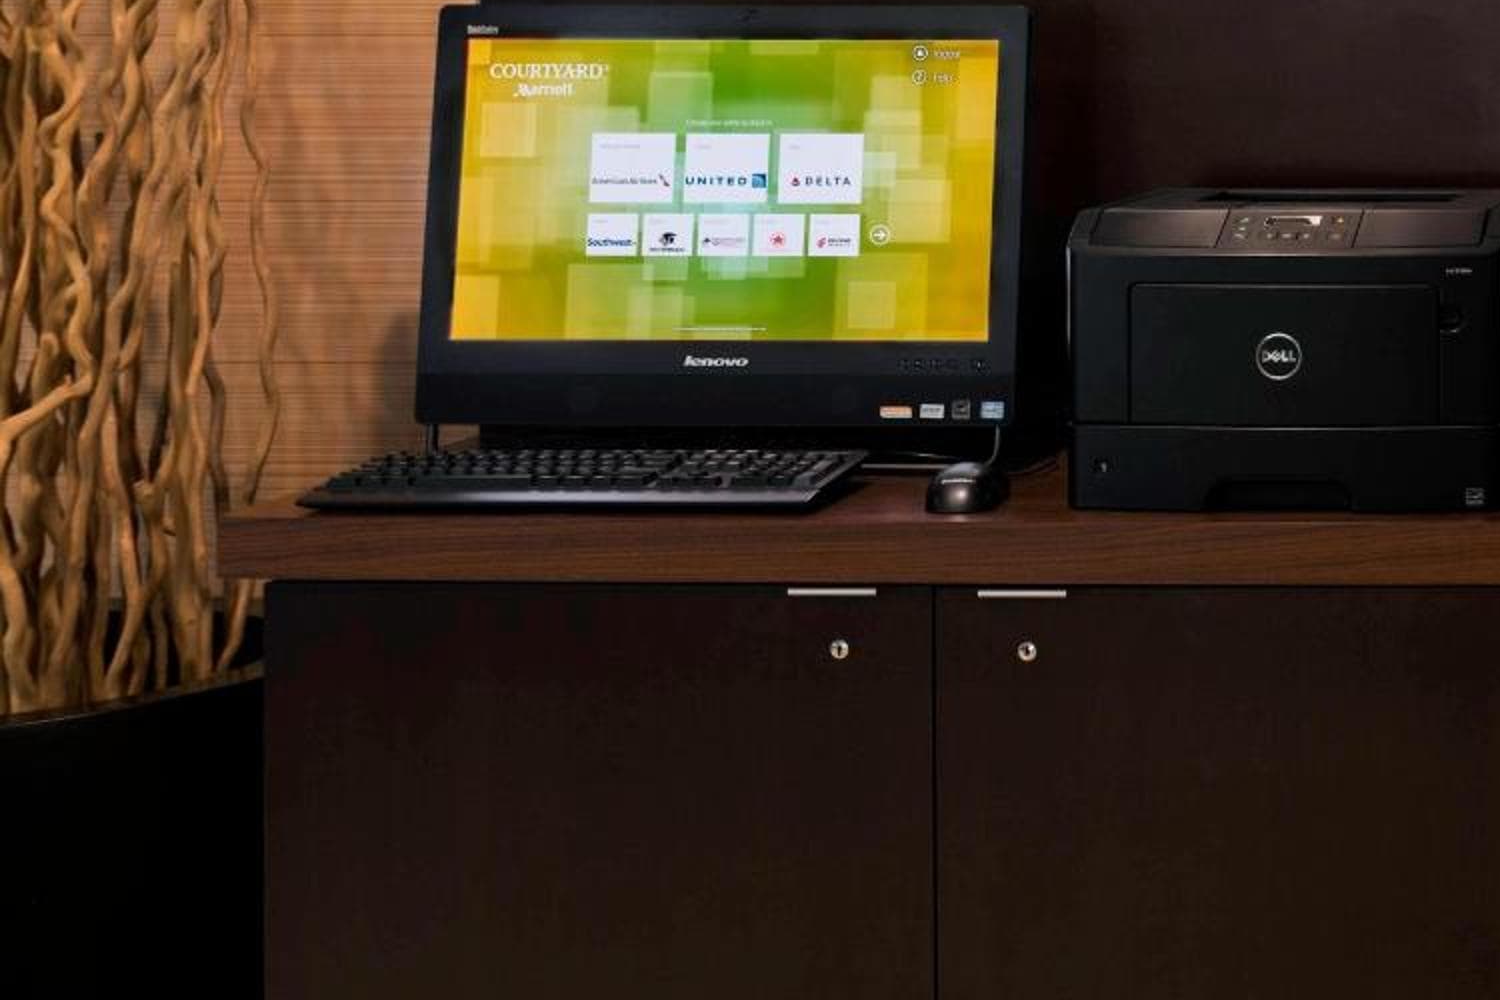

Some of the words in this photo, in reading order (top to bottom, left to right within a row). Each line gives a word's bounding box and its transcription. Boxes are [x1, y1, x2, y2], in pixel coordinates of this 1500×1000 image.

[489, 62, 604, 79] COURTYARD
[685, 176, 748, 186] UNITED
[805, 176, 851, 186] DELTA
[683, 354, 749, 367] lenovo
[1262, 350, 1297, 363] DELL
